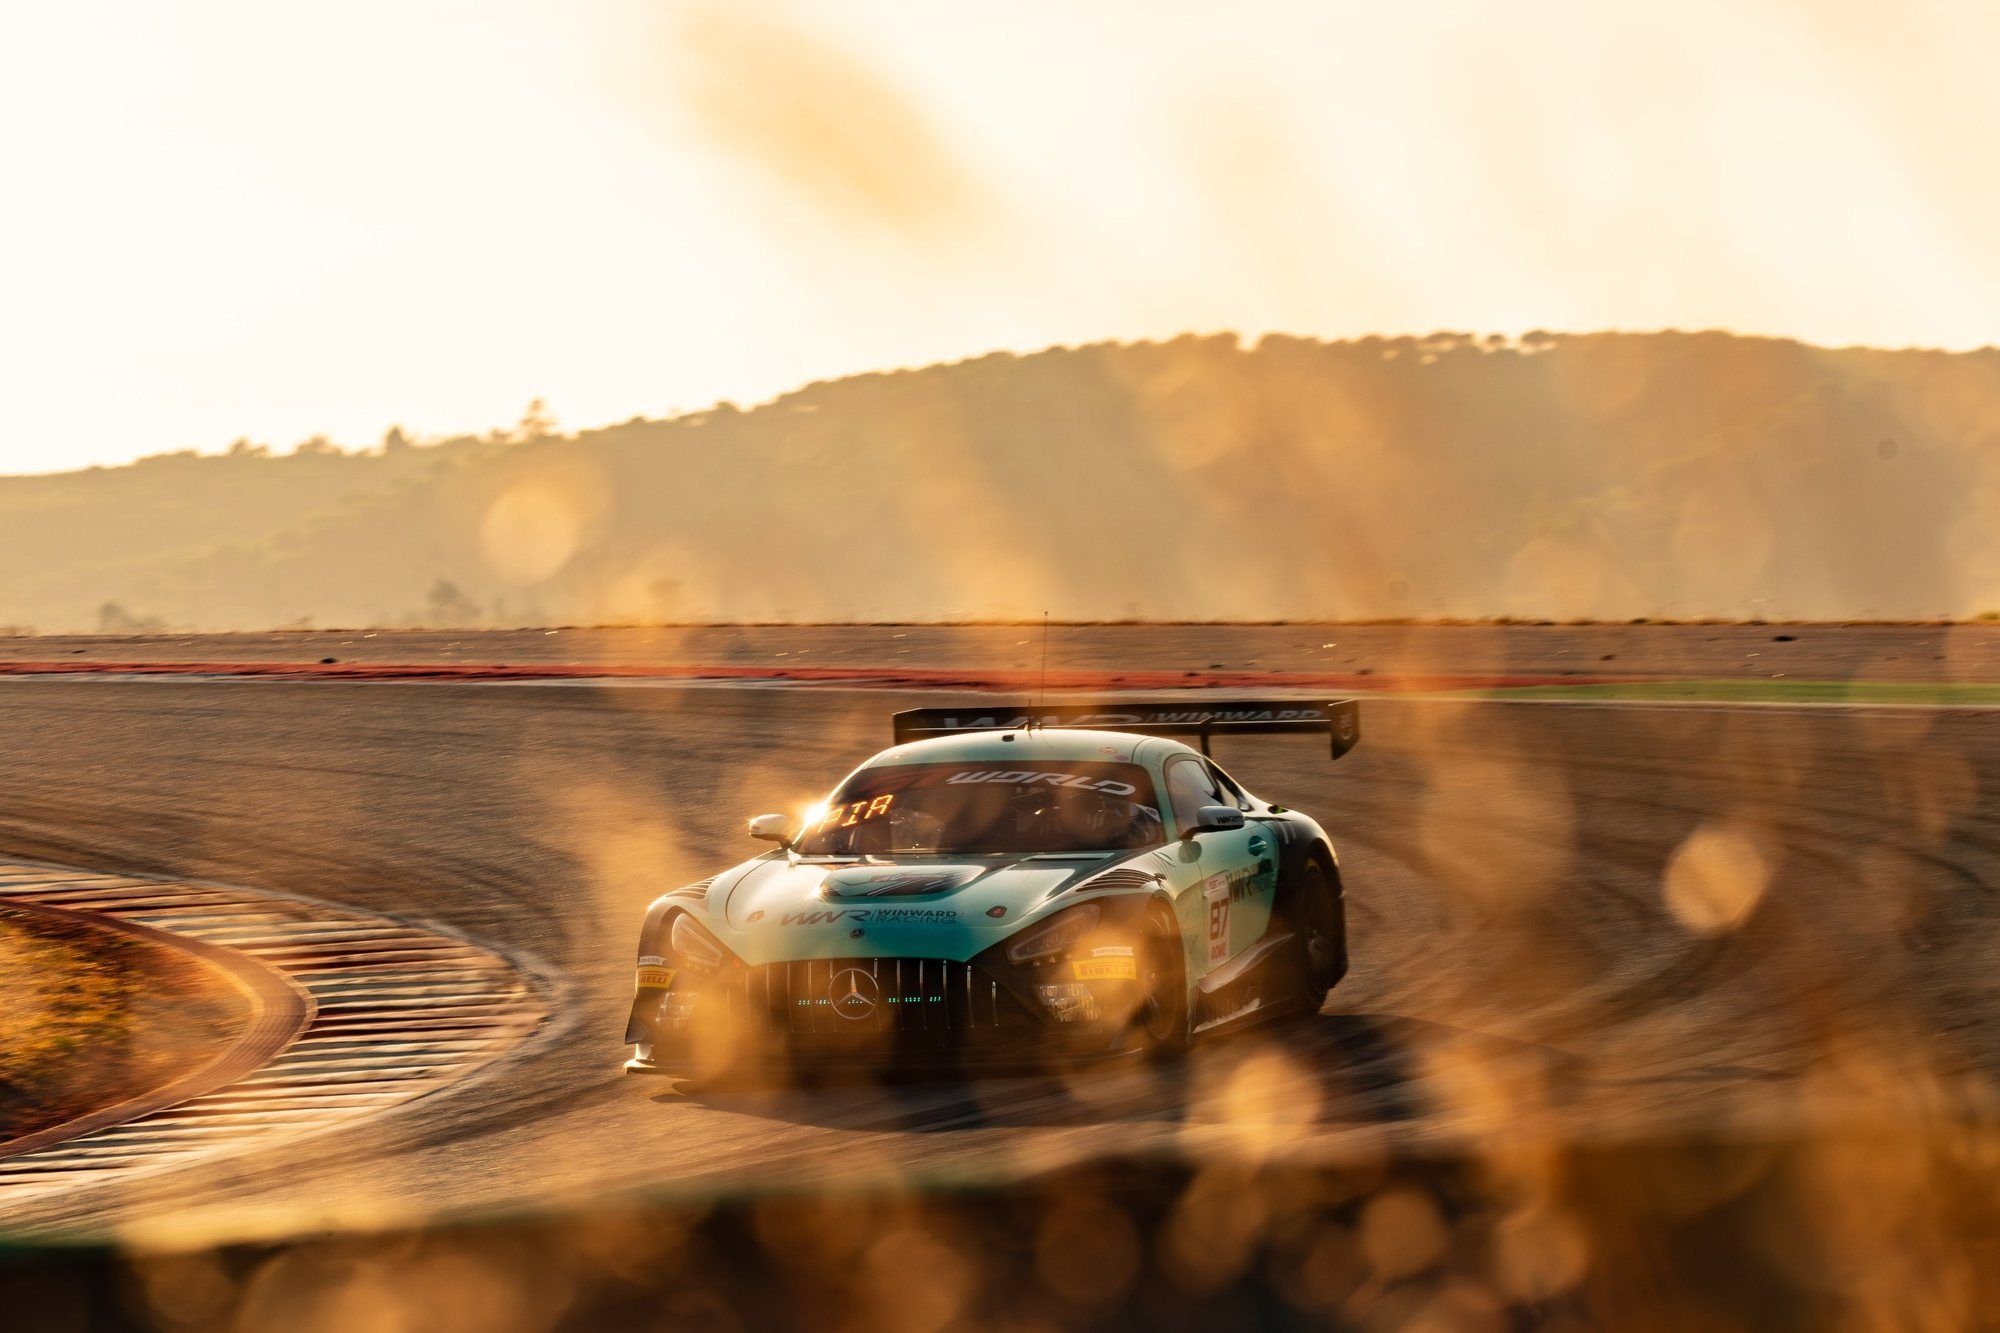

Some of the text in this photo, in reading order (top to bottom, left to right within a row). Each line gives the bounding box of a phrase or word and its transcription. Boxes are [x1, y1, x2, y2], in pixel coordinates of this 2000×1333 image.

[1155, 710, 1323, 723] WINWARD
[946, 771, 1137, 796] WORLD
[877, 909, 957, 918] WINWARD
[1210, 897, 1230, 941] 87
[875, 916, 957, 925] RACING
